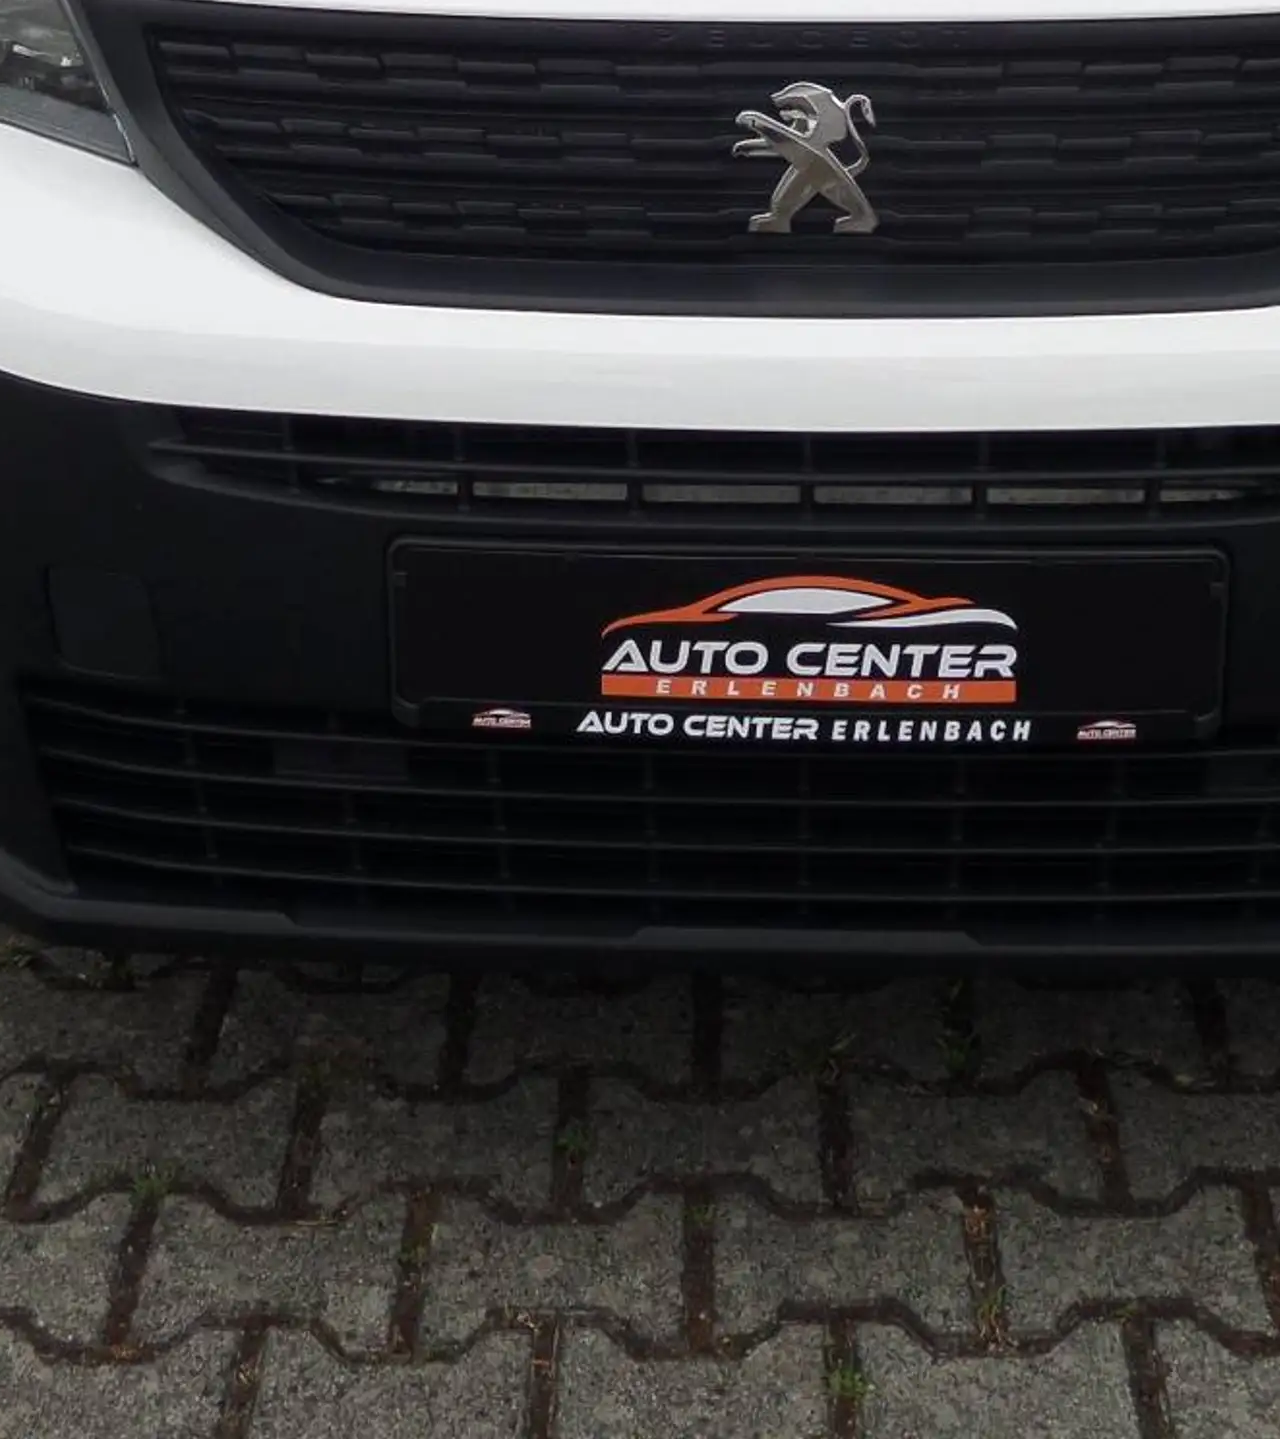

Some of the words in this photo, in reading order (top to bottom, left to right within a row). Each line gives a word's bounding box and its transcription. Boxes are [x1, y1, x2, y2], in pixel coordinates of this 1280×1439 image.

[601, 639, 768, 675] AUTO
[786, 642, 1018, 679] CENTER
[655, 679, 962, 700] ERLENBACH
[576, 710, 674, 735] AUTO
[682, 715, 820, 741] CENTER
[831, 719, 1032, 743] ERLENBACH
